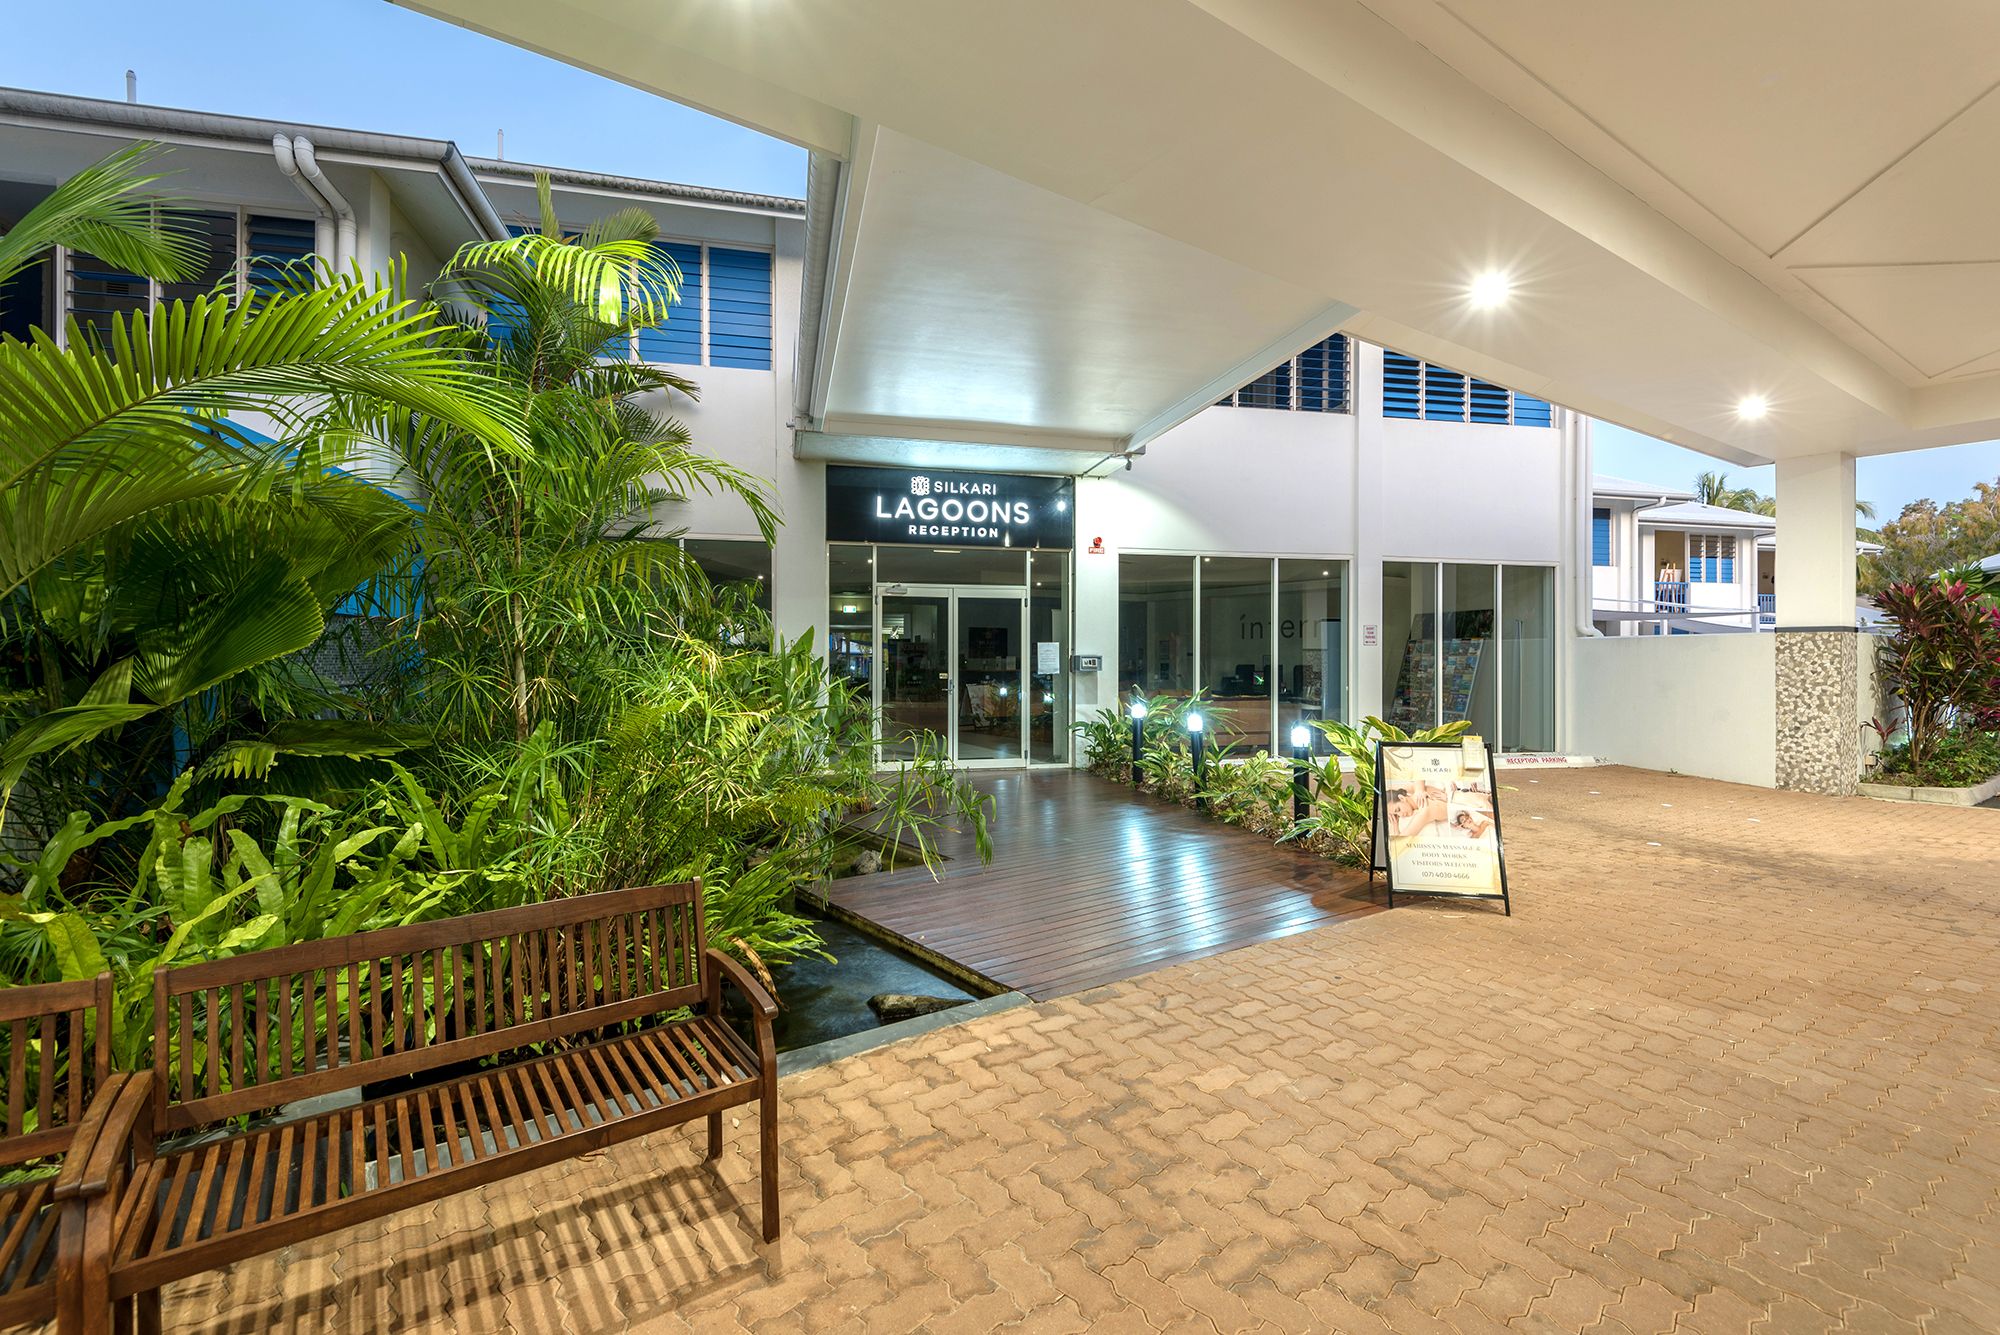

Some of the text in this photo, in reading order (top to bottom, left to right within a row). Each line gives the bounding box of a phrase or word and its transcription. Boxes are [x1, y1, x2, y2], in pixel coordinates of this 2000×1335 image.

[934, 481, 997, 496] SILKARI
[875, 495, 1031, 524] LAGOONS
[908, 524, 999, 538] RECEPTION
[1421, 871, 1435, 879] (07)
[1435, 871, 1452, 879] 4030
